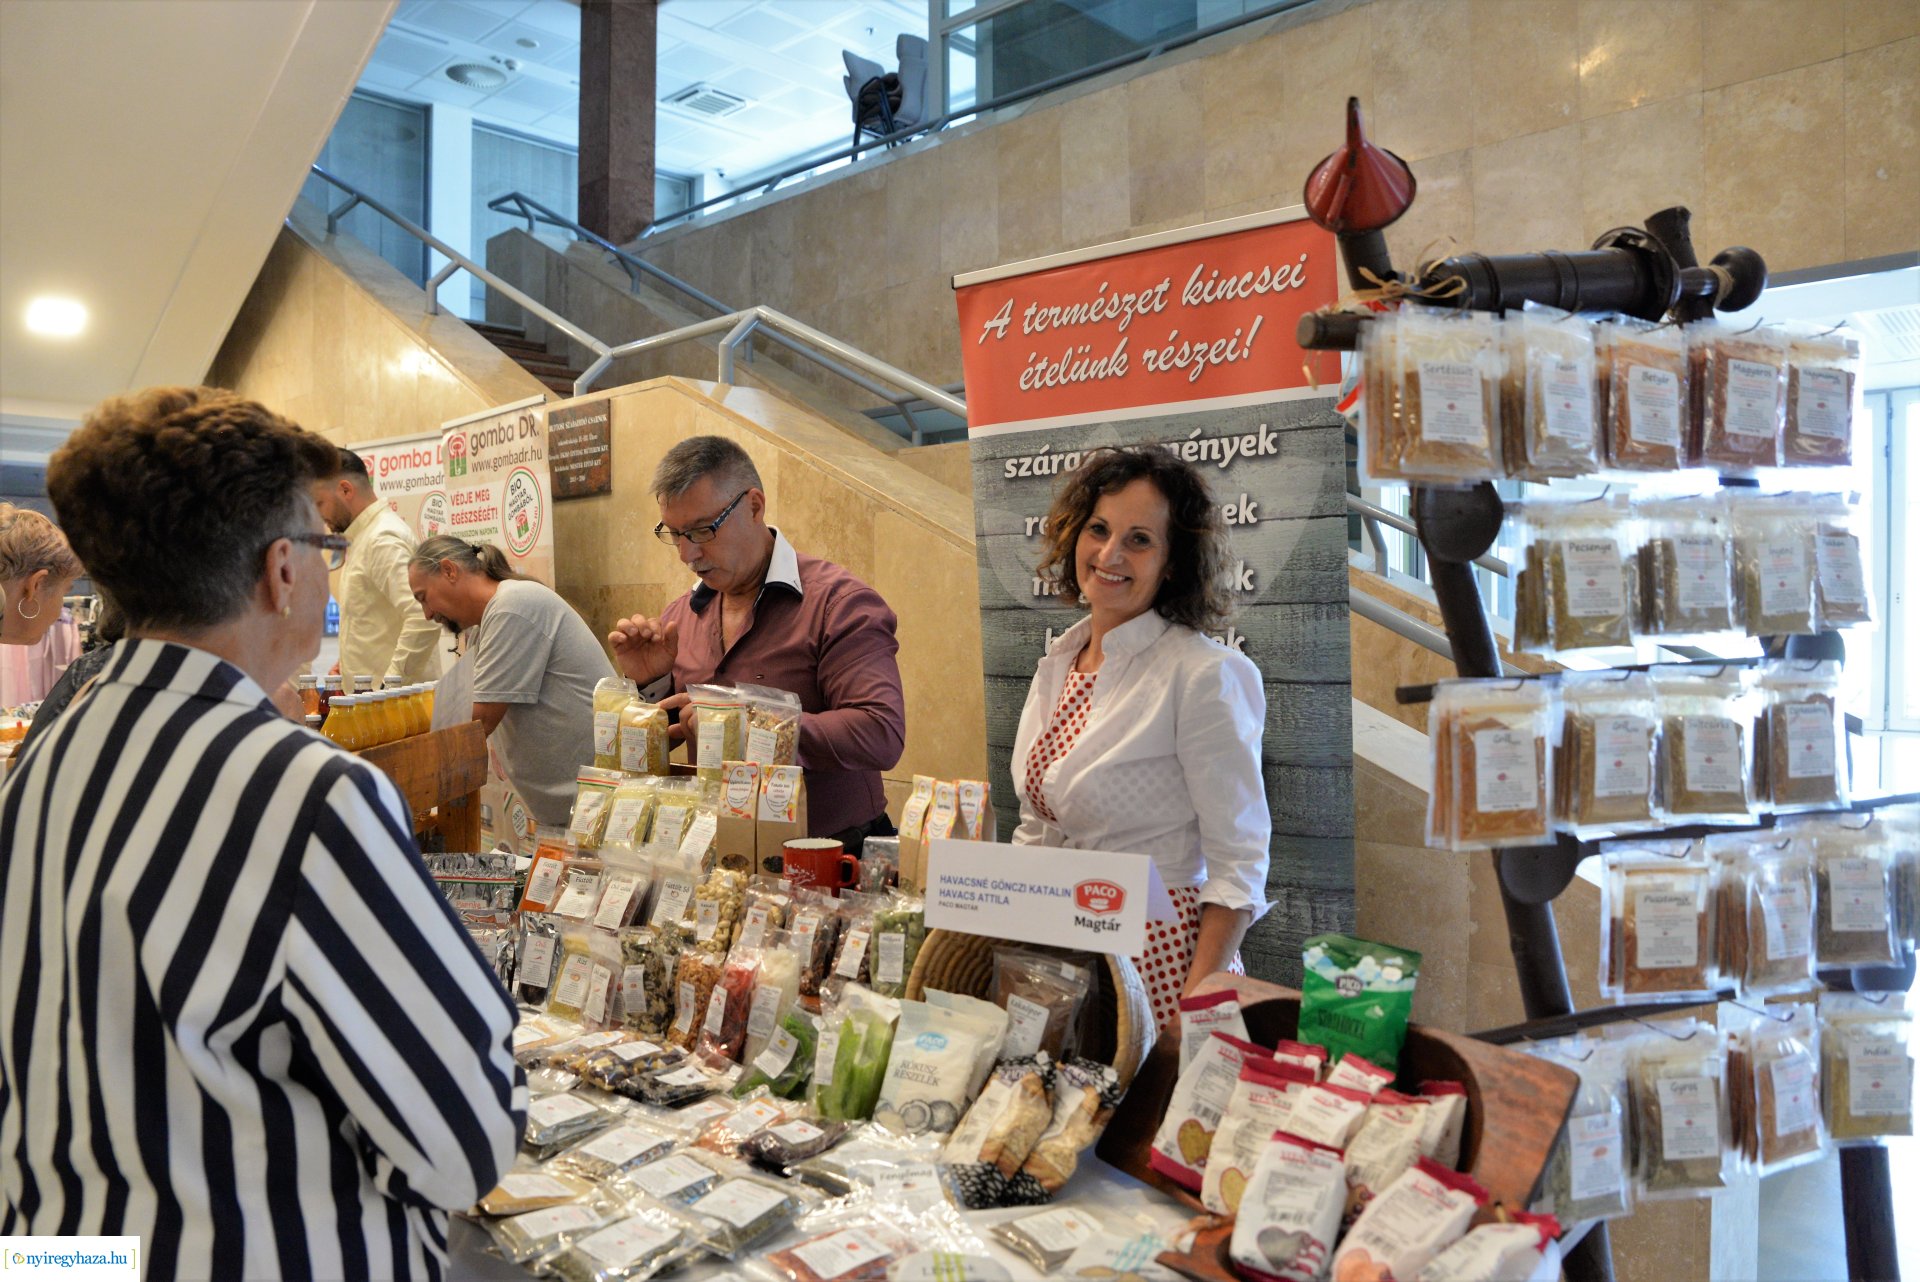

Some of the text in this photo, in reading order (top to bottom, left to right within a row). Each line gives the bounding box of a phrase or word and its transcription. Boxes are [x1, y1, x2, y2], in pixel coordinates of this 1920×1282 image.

[977, 252, 1309, 345] A természet kincsei
[1018, 314, 1264, 392] ételünk részei!
[471, 414, 540, 457] gomba DR.
[379, 448, 431, 477] gomba
[471, 445, 543, 473] www.gombadr.hu
[379, 473, 445, 491] www.gombadr
[510, 478, 523, 496] BIO
[431, 498, 443, 508] BIO
[451, 488, 490, 506] VÉDJE MEG
[508, 488, 527, 508] MAGYAR
[451, 505, 498, 525] EGÉSZSÉGÉT!
[939, 874, 1072, 898] HAVACSNÉ GÖNCZI KATALIN
[1084, 884, 1117, 899] PACO
[939, 888, 1010, 905] HAVACS ATTILA
[1074, 915, 1121, 933] Magtár
